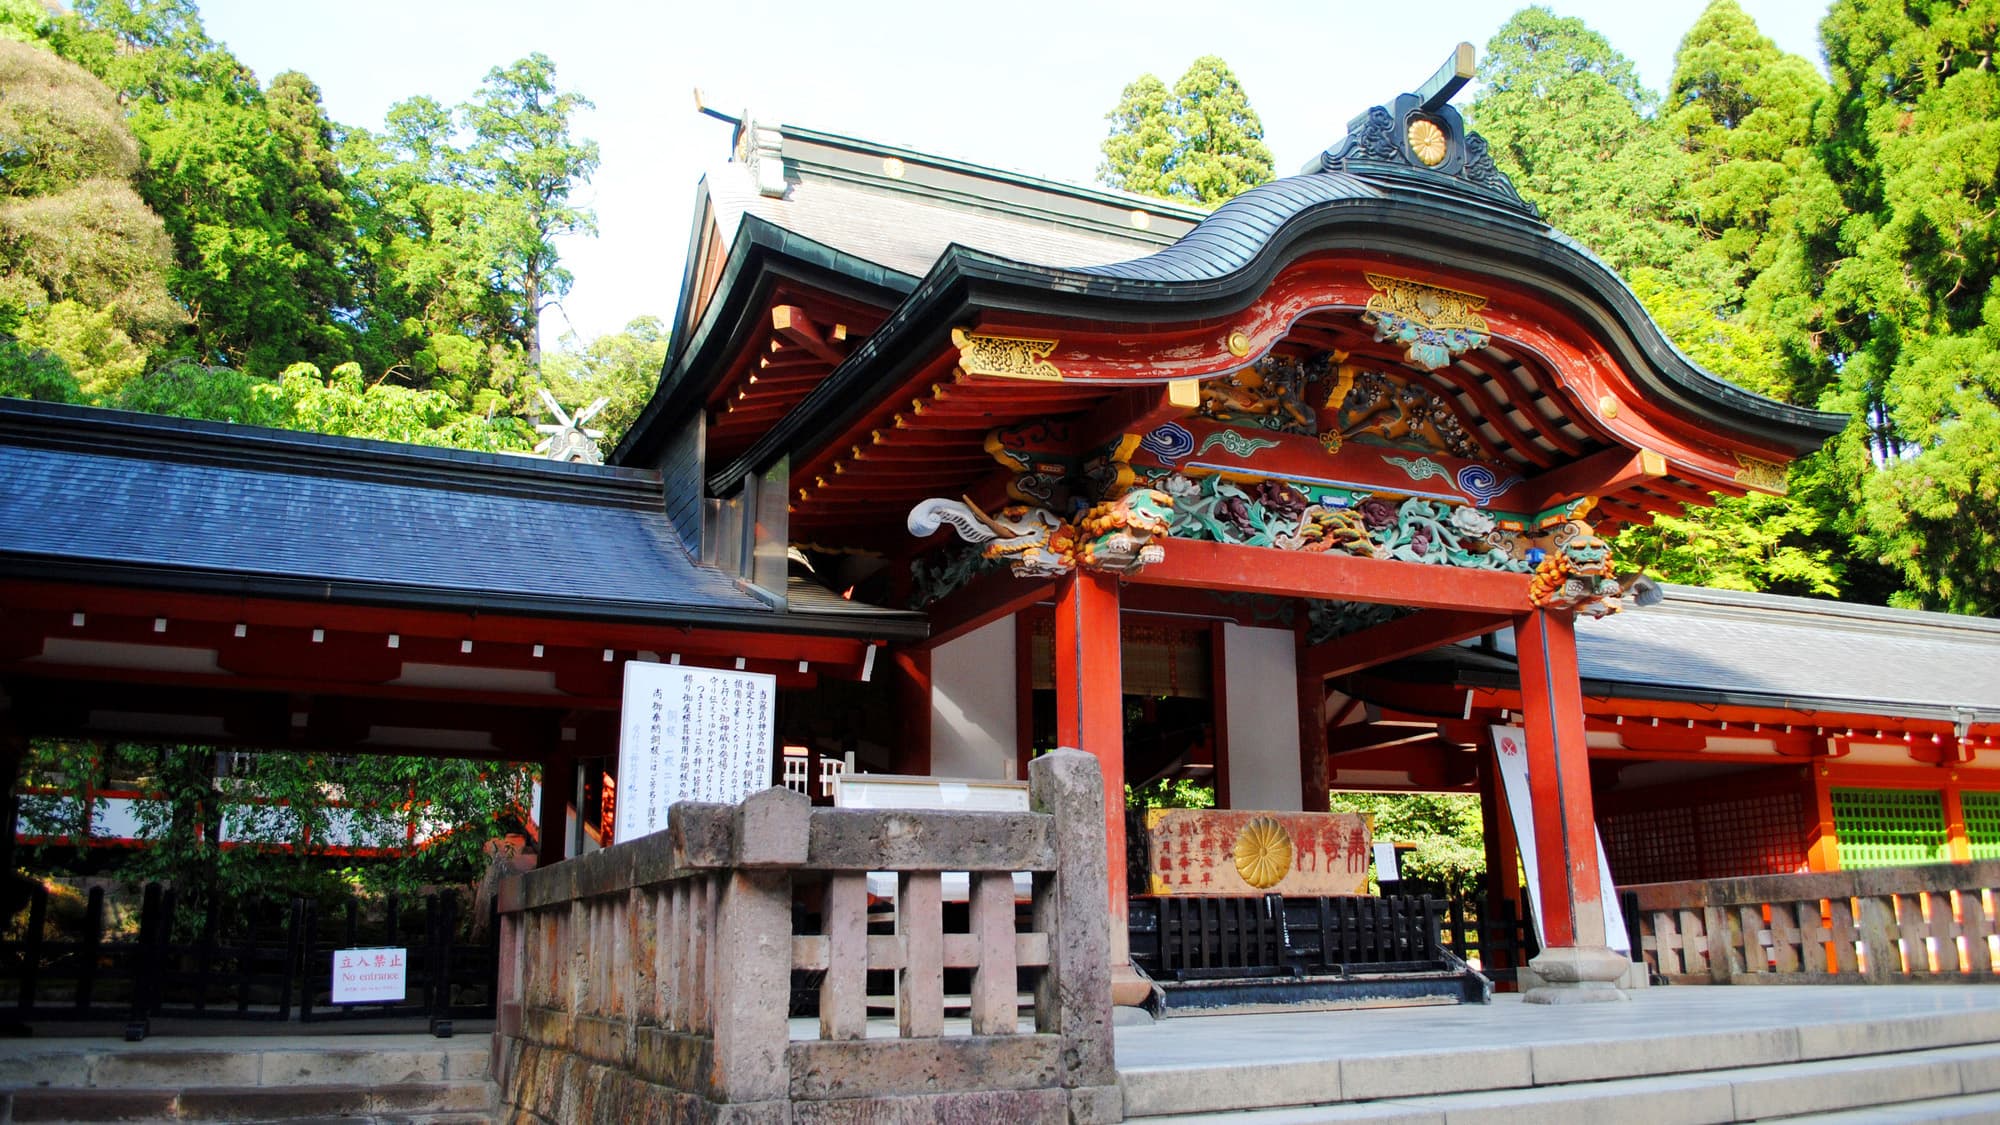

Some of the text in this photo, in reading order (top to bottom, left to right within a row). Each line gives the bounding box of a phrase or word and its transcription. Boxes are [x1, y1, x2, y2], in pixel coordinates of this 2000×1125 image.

[755, 689, 767, 791] 当霧島神宮の御社殿は平
[339, 954, 404, 969] 立入禁止
[342, 972, 399, 982] No entrance
